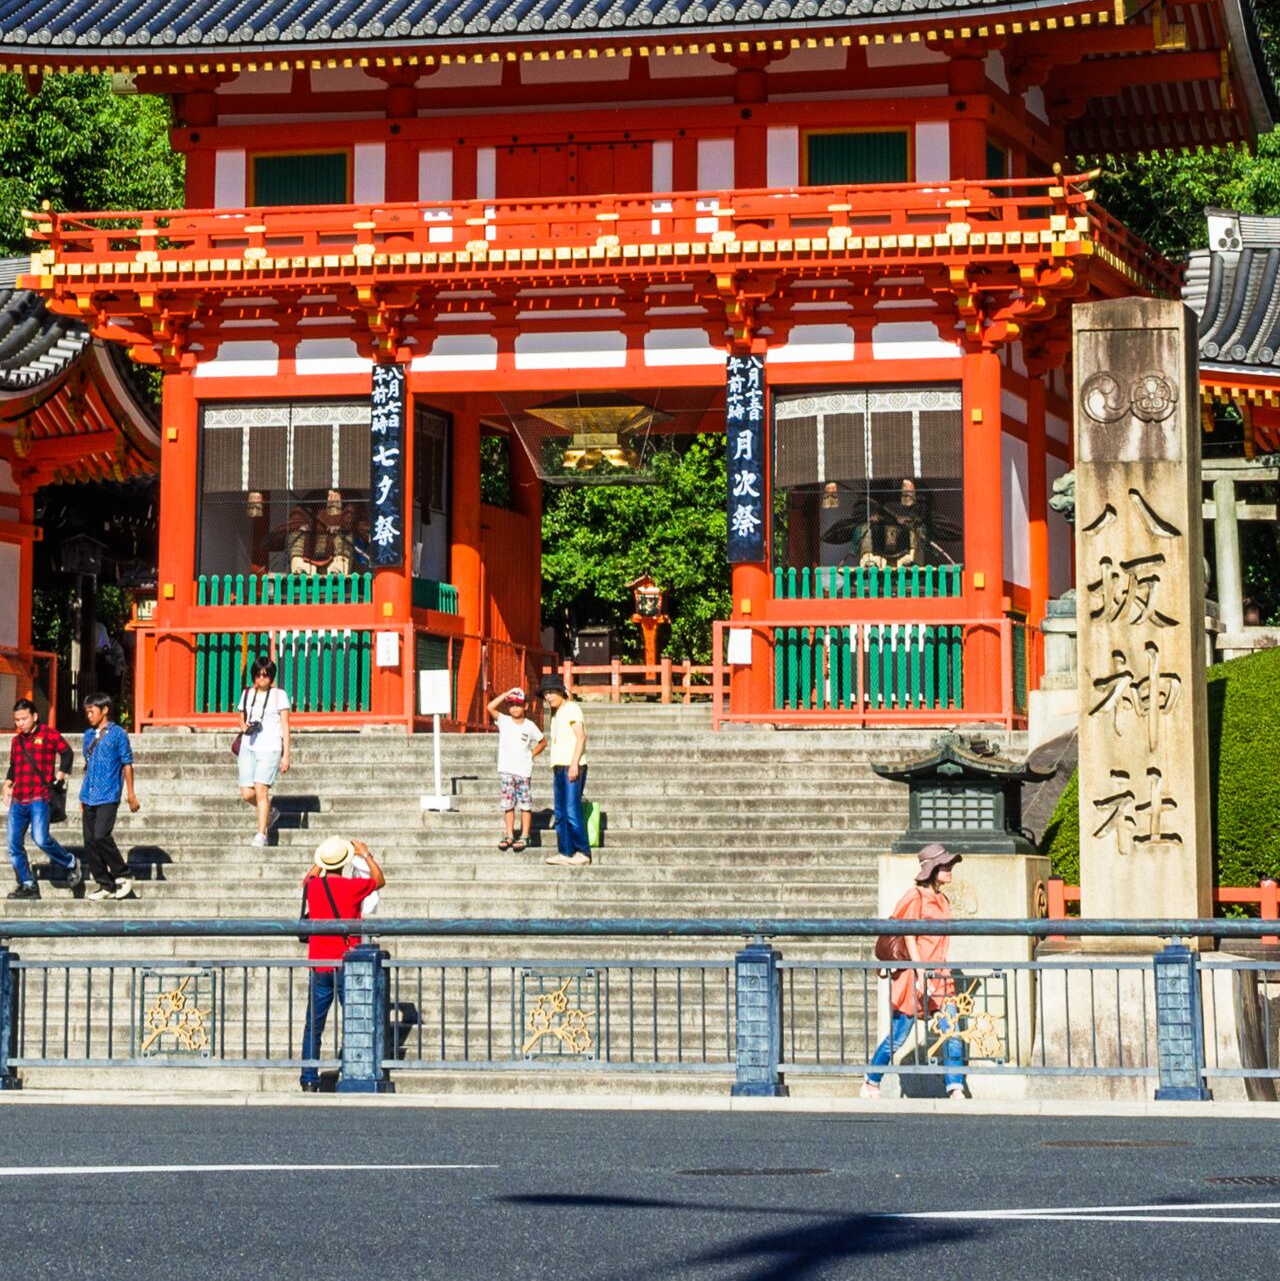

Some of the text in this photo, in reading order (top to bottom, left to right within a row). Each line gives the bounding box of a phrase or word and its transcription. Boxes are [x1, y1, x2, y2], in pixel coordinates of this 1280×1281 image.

[371, 366, 389, 434] 午前十時
[385, 366, 404, 428] 八月七日
[726, 356, 746, 420] 午前十時
[372, 445, 401, 546] 七夕祭
[730, 429, 761, 537] 月次祭
[1082, 487, 1182, 855] 八坂神社
